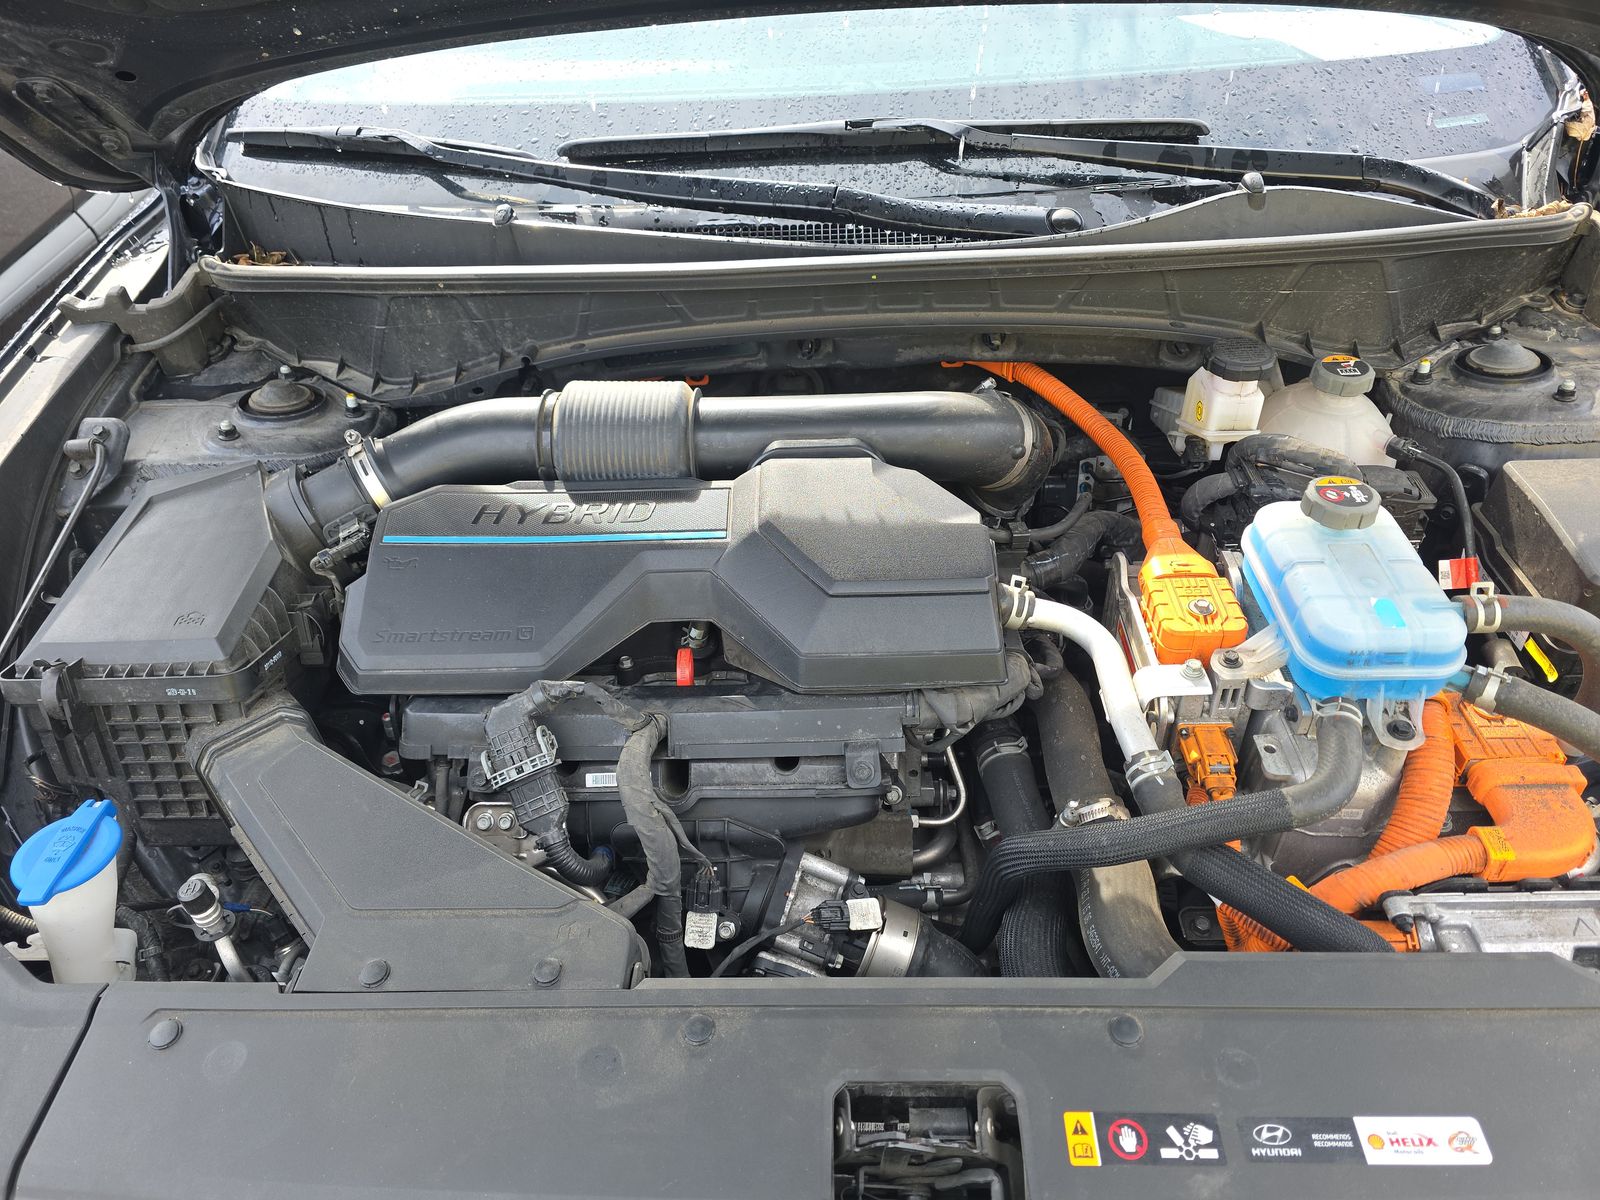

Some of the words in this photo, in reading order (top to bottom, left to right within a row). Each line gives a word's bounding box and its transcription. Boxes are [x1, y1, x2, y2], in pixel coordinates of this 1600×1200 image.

[471, 501, 657, 525] HYBRID
[371, 628, 512, 644] Smartstream
[1388, 1136, 1439, 1147] HELIX
[1251, 1147, 1302, 1157] HYUNDAI
